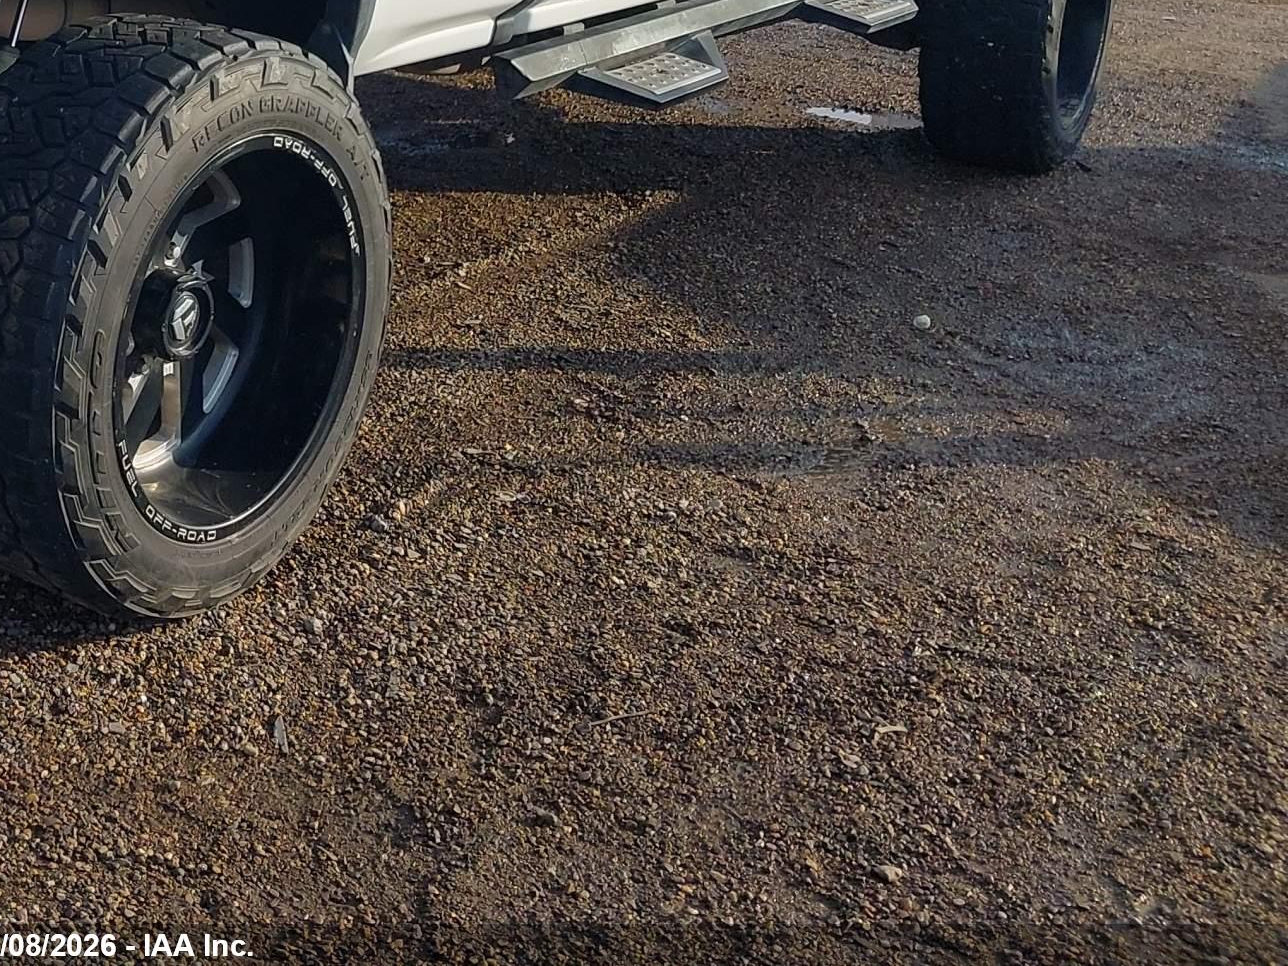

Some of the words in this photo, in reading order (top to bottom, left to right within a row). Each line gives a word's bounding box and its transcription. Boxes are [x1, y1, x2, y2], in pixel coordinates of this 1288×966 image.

[259, 95, 343, 141] GRAPPLER
[273, 136, 338, 187] OFF-ROAD
[118, 439, 139, 498] FUEL
[145, 504, 217, 542] OFF-ROAD
